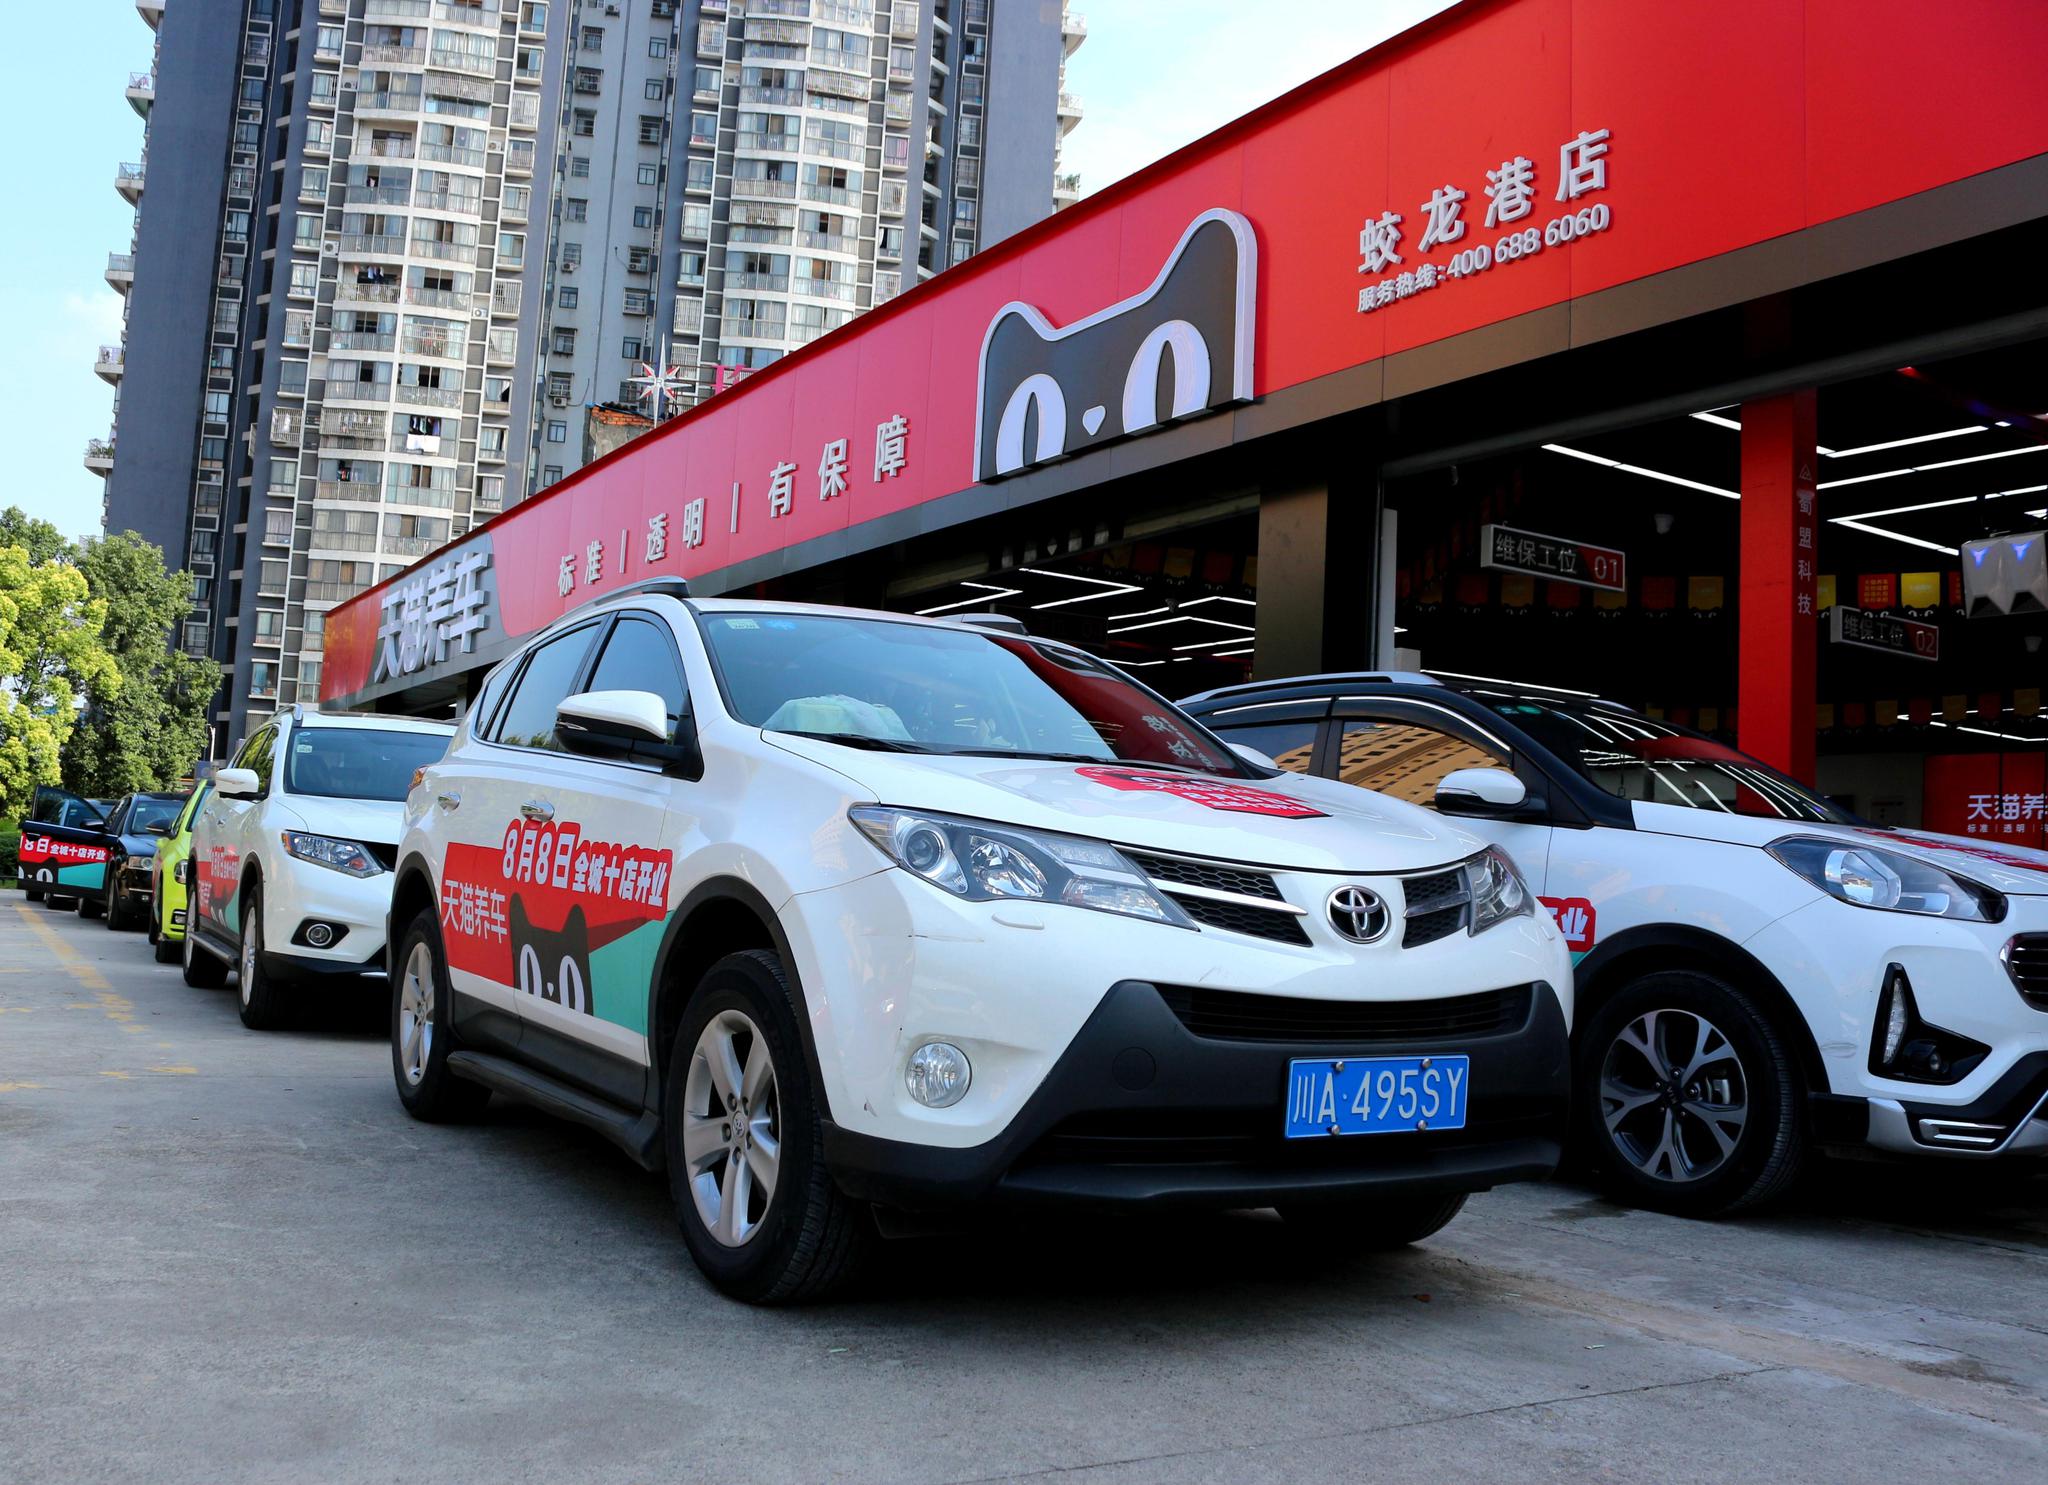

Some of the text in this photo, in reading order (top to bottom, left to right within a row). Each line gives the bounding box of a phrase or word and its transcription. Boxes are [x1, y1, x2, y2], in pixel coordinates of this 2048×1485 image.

[1358, 128, 1610, 273] 蛟龙港店
[1494, 227, 1541, 264] 688
[1544, 203, 1610, 247] 6060
[1496, 534, 1618, 582] 维保工位 01
[374, 551, 495, 683] 天猫养车
[1915, 630, 1936, 653] 02
[1967, 793, 2048, 820] 天猫养
[502, 828, 576, 889] 8月8日
[442, 878, 508, 943] 天猫养车
